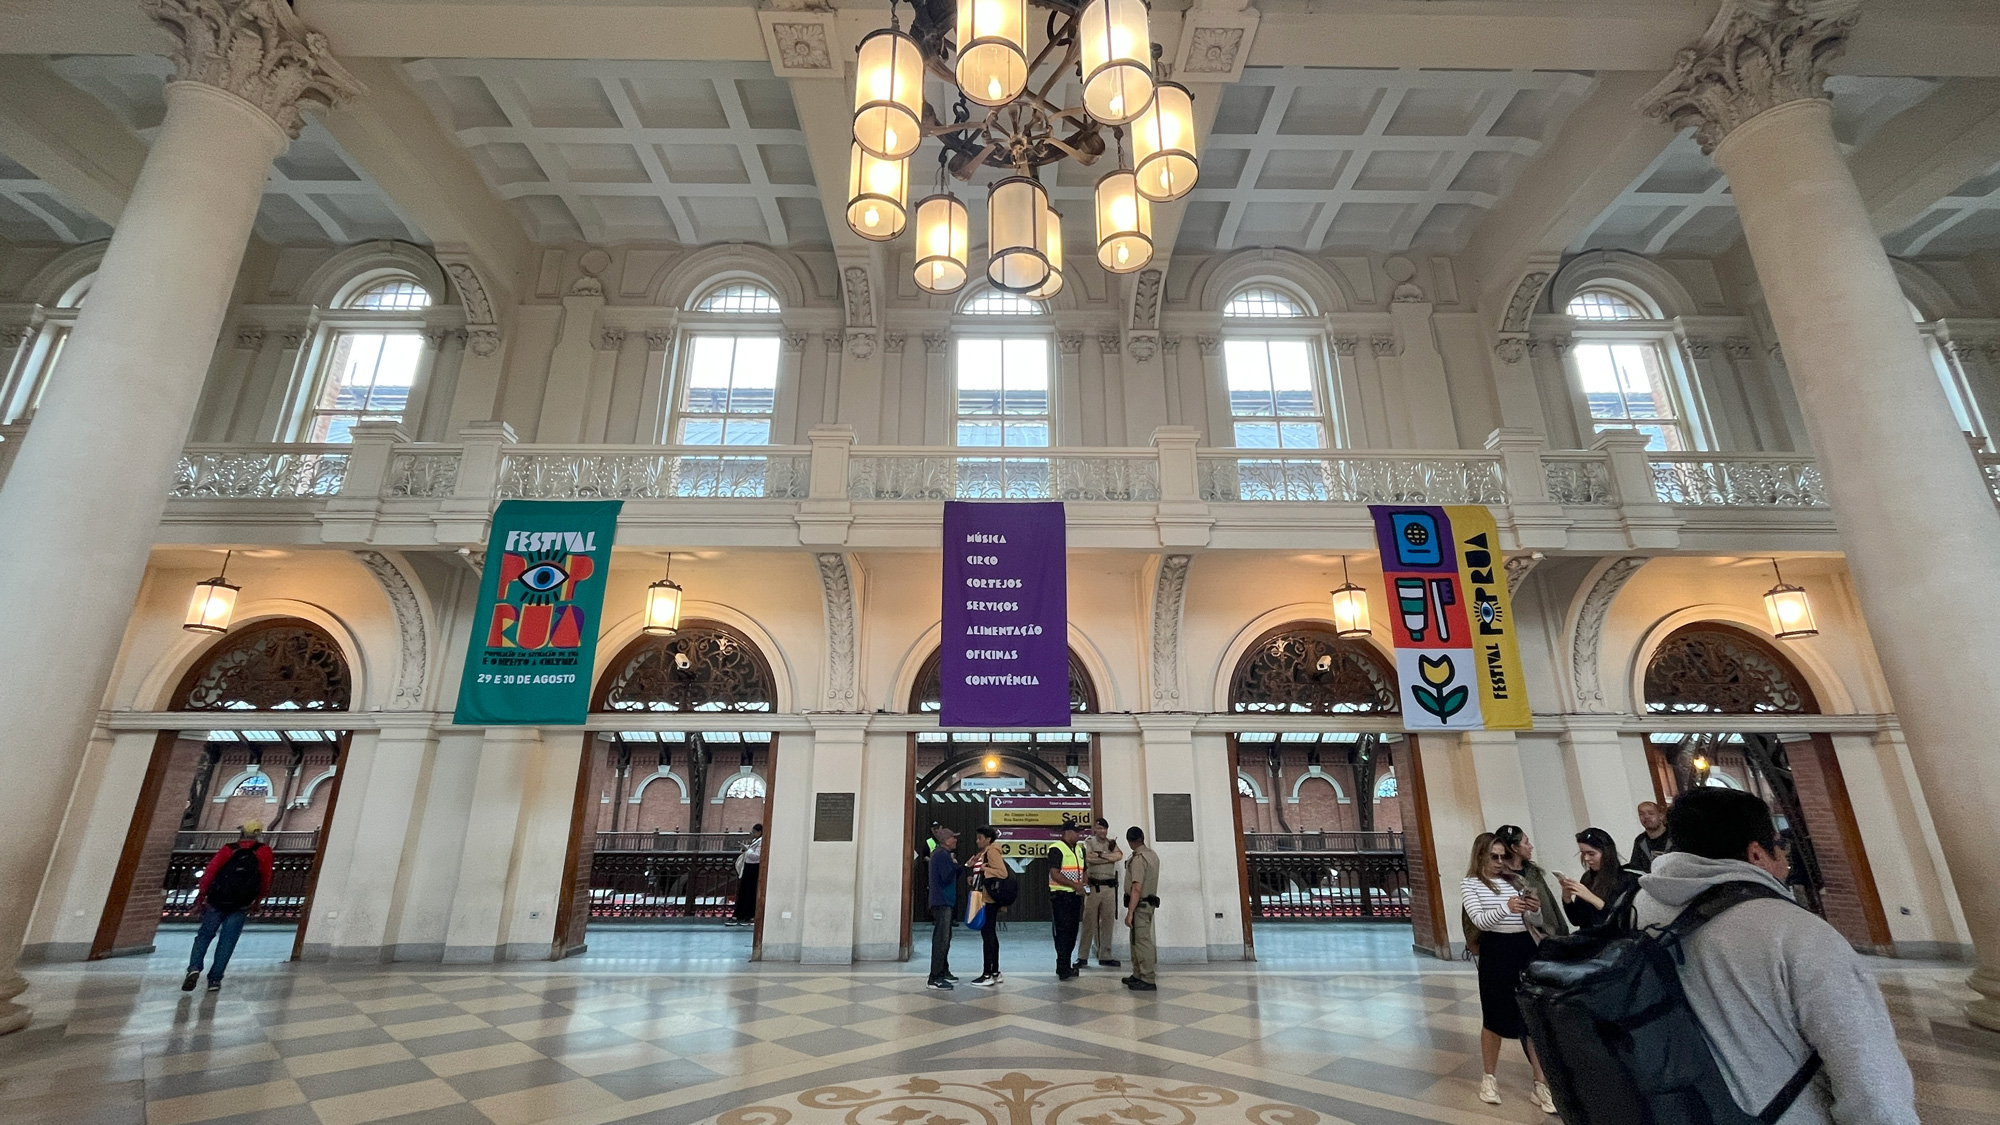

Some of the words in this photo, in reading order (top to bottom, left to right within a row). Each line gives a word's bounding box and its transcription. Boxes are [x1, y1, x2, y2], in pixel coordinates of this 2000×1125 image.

[505, 531, 597, 552] FESTIVAL
[966, 532, 1007, 544] MÚSICA
[966, 555, 999, 566] CIRCO
[1464, 532, 1495, 584] RUA
[966, 578, 1023, 589] CORTEJOS
[966, 601, 1019, 612] SERVIÇOS
[486, 603, 585, 650] RUA
[966, 624, 1043, 636] ALIMENTAÇÃO
[965, 649, 1019, 660] OFICINAS
[1485, 643, 1509, 700] FESTIVAL
[477, 674, 492, 683] 29
[494, 675, 501, 684] E
[503, 675, 514, 684] 30
[517, 675, 531, 684] DE
[533, 674, 576, 684] AGOSTO
[965, 673, 1040, 686] CONVIVÊNCIA
[1062, 811, 1090, 823] Saíd
[1018, 843, 1049, 856] Saíd
